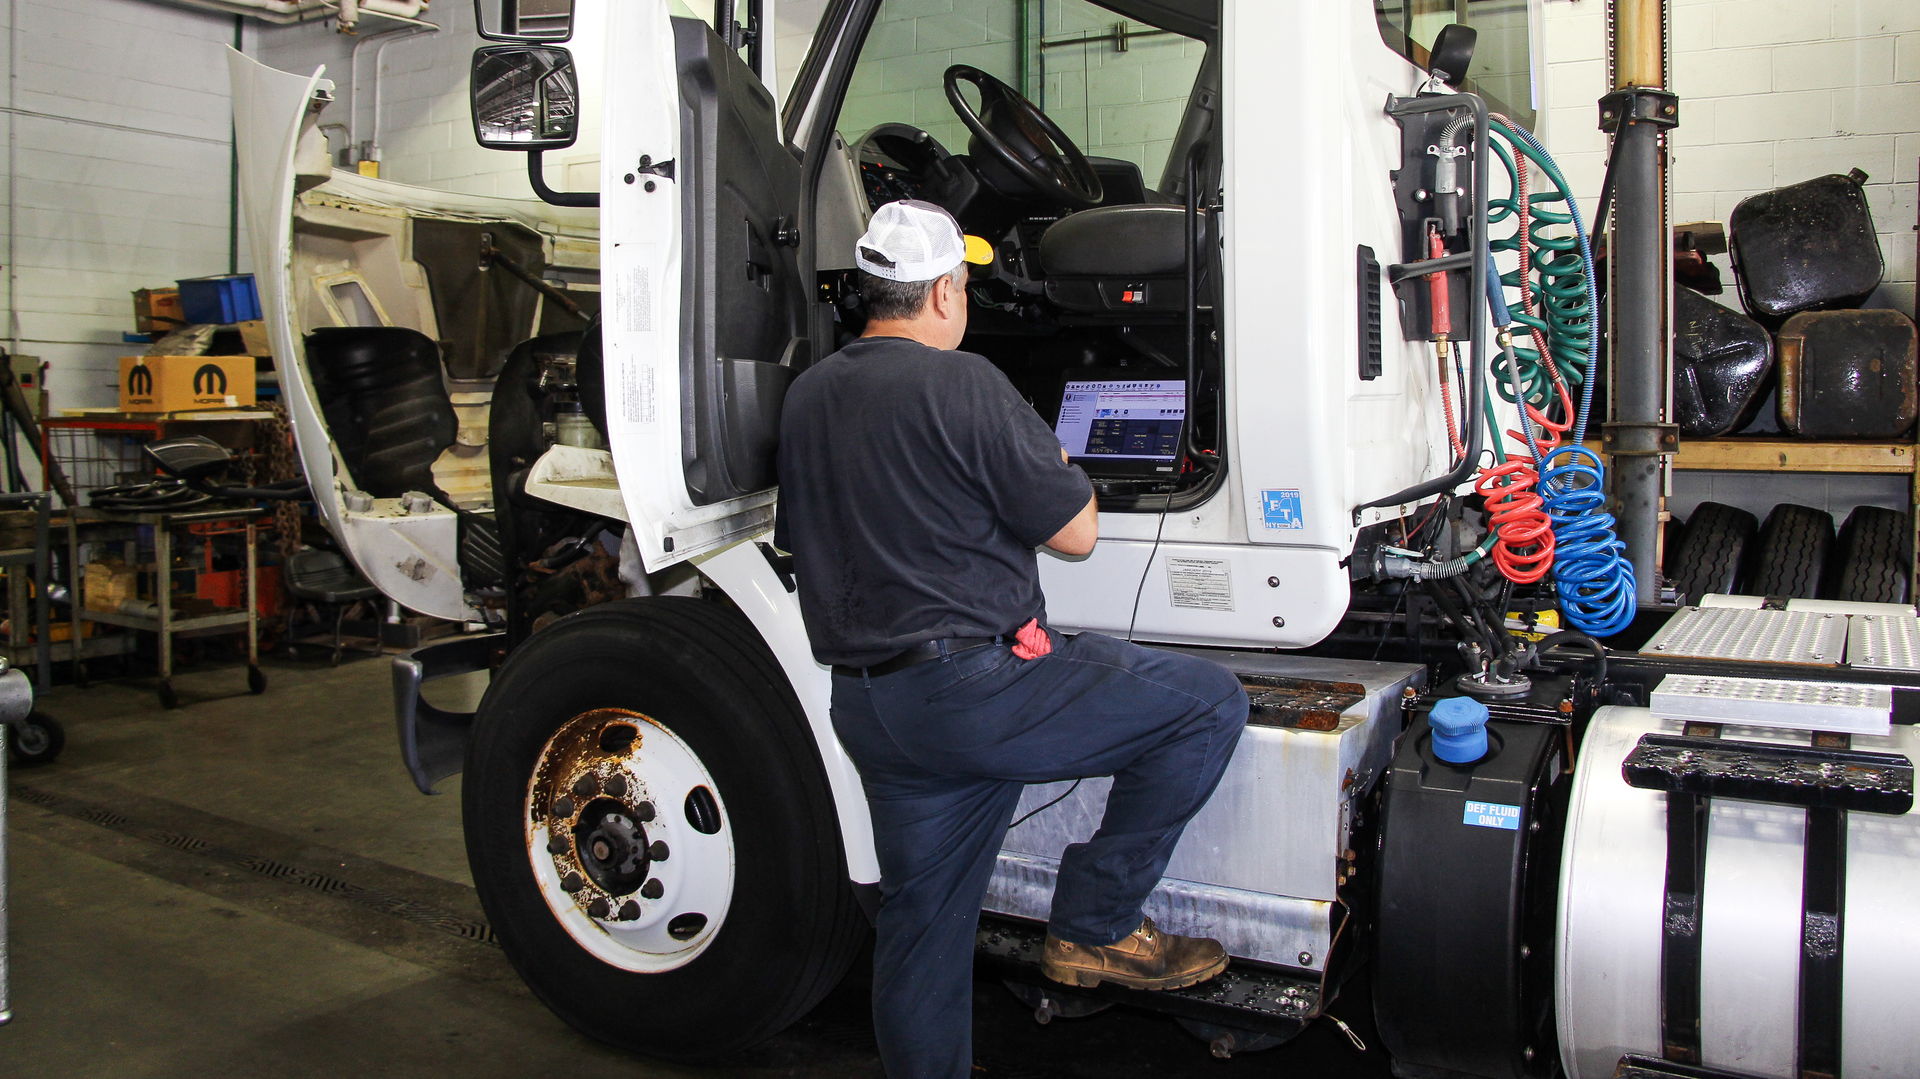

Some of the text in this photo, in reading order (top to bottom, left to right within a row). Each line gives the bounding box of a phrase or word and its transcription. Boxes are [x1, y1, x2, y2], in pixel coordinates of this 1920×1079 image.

[1467, 803, 1518, 817] DEF FLUID
[1479, 815, 1504, 826] ONLY
